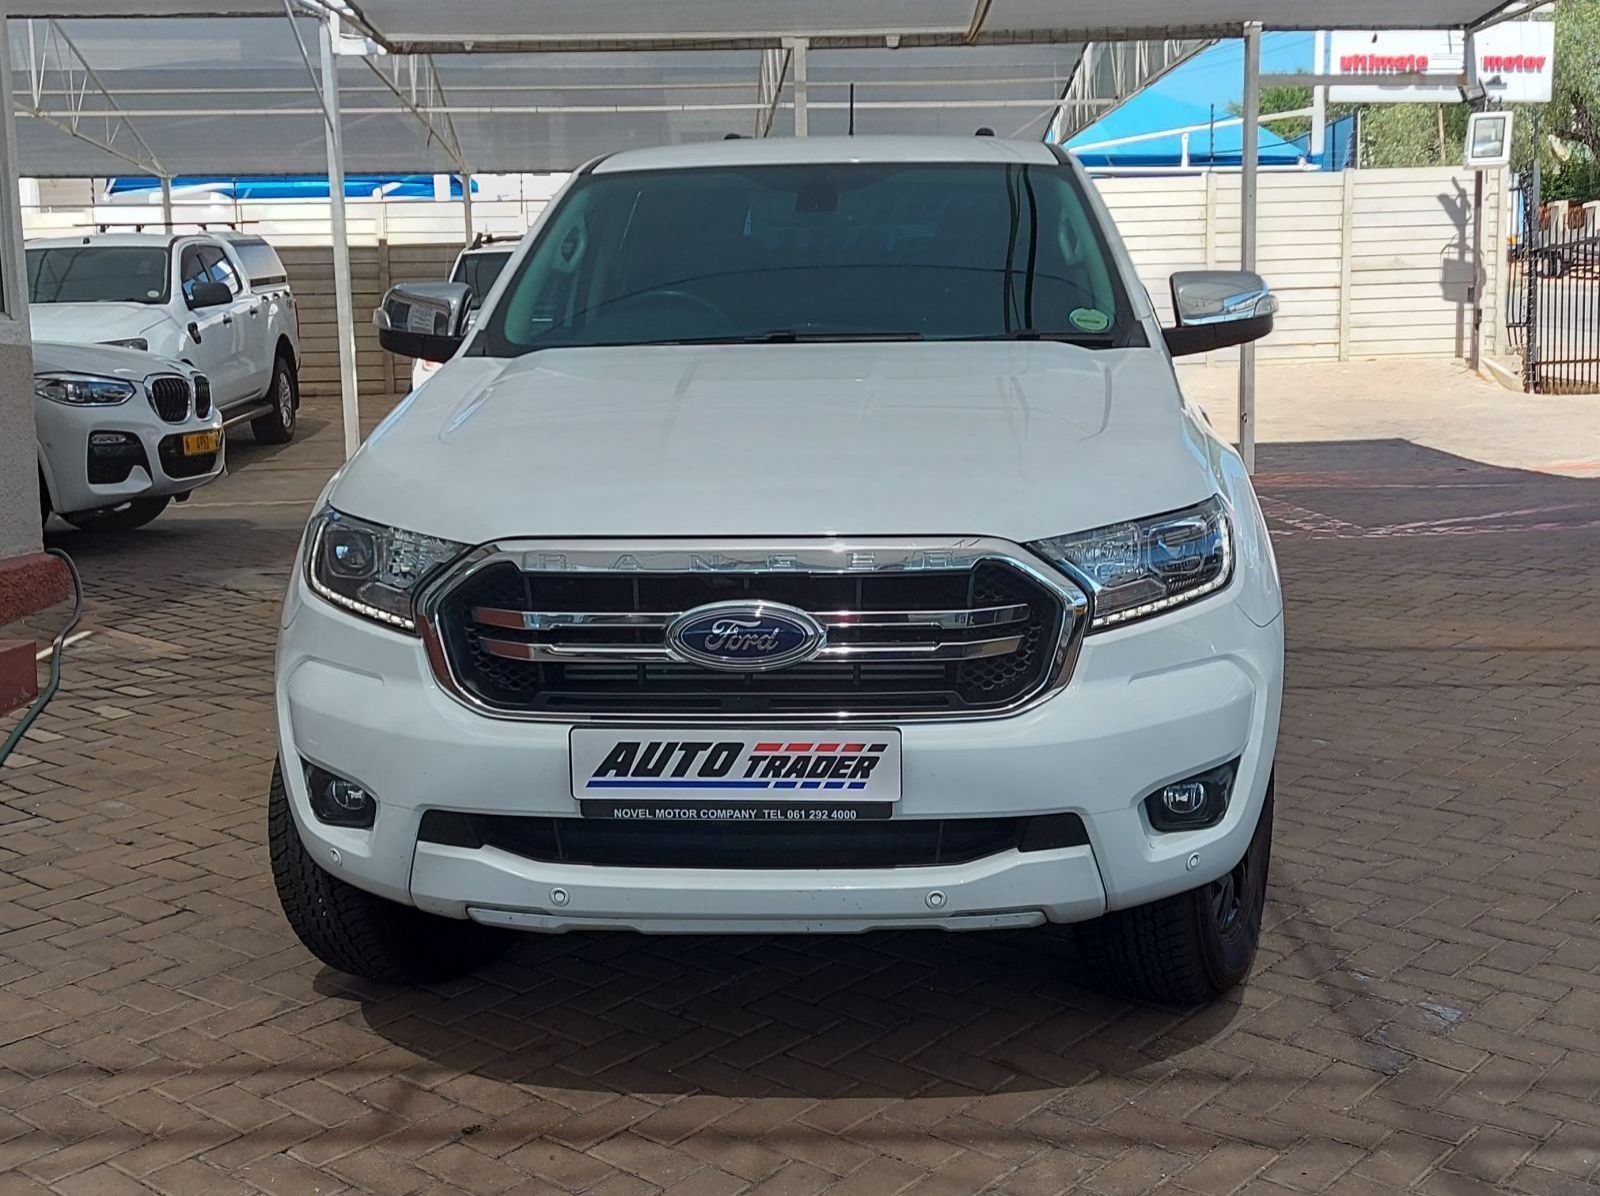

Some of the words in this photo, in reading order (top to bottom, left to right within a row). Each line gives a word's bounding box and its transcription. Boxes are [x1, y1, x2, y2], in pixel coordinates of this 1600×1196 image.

[1339, 54, 1429, 74] ultimate
[1482, 54, 1546, 74] motor
[703, 618, 781, 652] Ford
[592, 741, 745, 777] AUTO
[743, 756, 880, 779] TRADER
[613, 808, 653, 819] NOVEL
[655, 808, 697, 819] MOTOR
[700, 808, 757, 819] COMPANY
[763, 809, 784, 819] TEL
[787, 809, 805, 819] 061
[809, 809, 828, 819] 292
[831, 809, 857, 819] 4000
